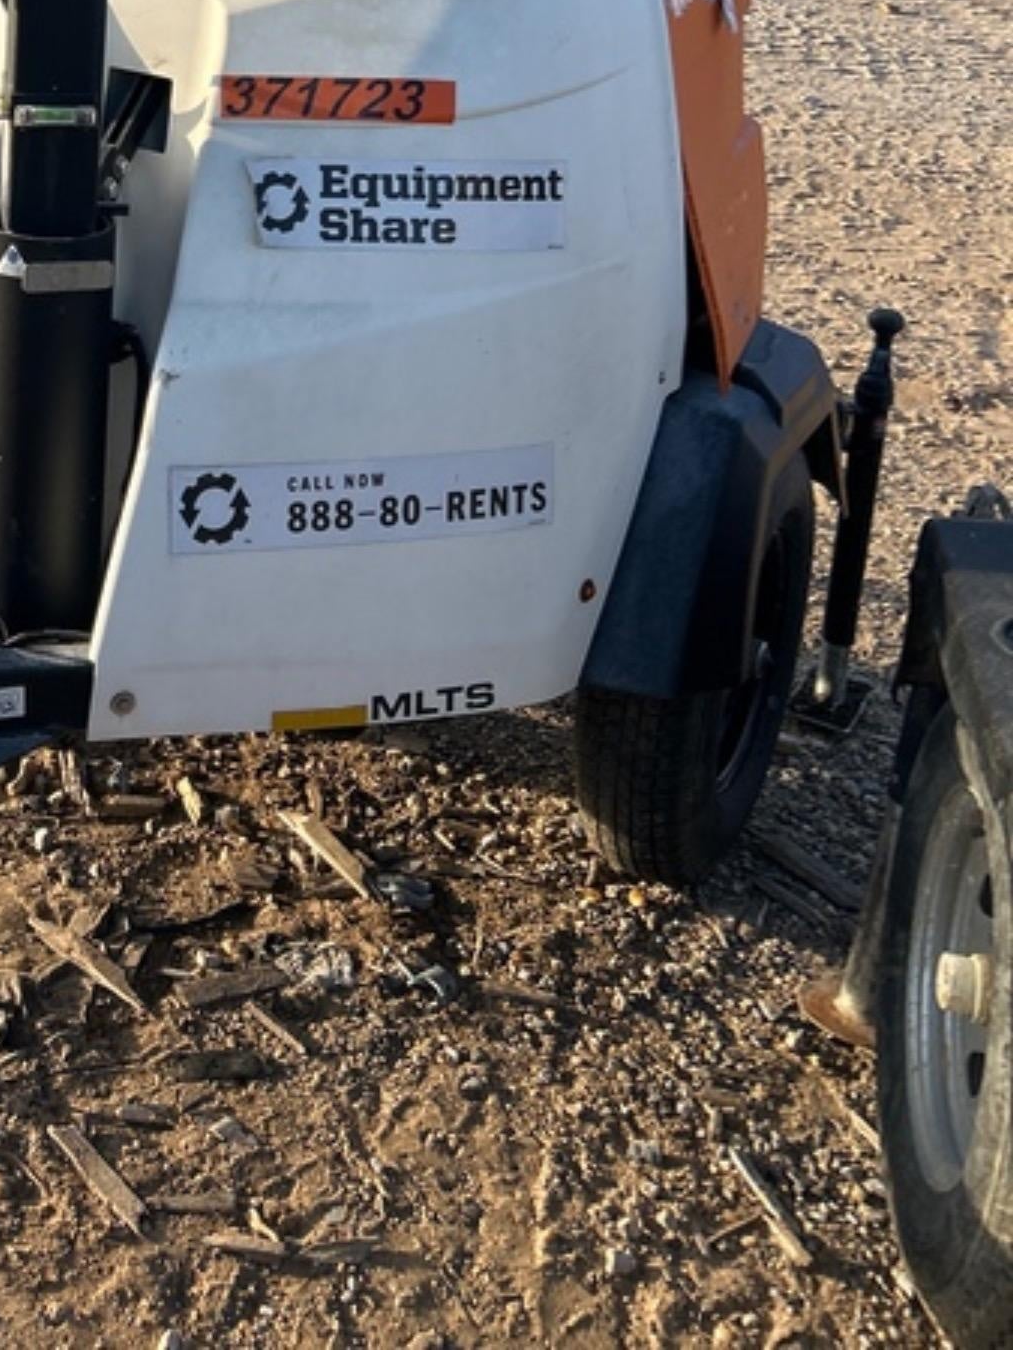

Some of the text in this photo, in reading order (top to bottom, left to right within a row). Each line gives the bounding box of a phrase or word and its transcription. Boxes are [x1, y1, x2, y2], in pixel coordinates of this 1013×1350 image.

[226, 77, 426, 120] 371723
[319, 164, 564, 207] Equipment
[319, 207, 457, 244] Share
[286, 472, 386, 492] CALL NOW
[287, 482, 548, 533] 888-80-RENTS
[371, 682, 496, 722] MLTS
